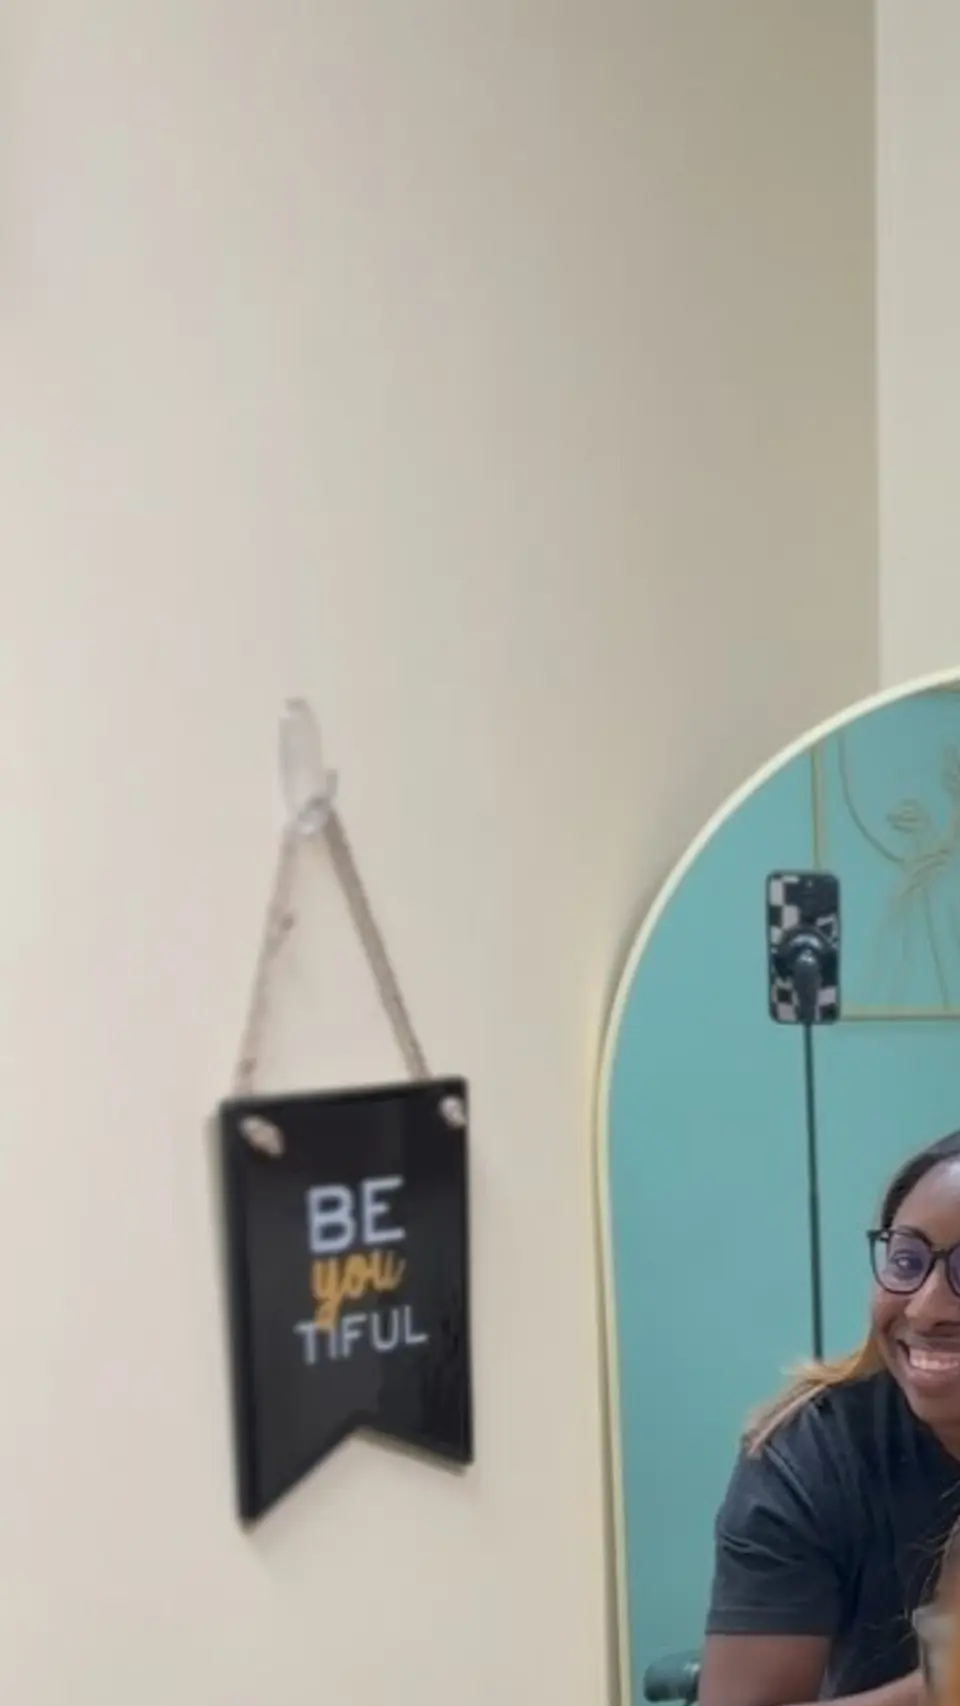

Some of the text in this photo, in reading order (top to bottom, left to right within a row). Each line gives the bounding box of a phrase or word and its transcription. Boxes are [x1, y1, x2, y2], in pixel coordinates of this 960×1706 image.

[306, 1174, 406, 1255] BE
[312, 1247, 407, 1331] you
[292, 1303, 430, 1366] TIFUL
